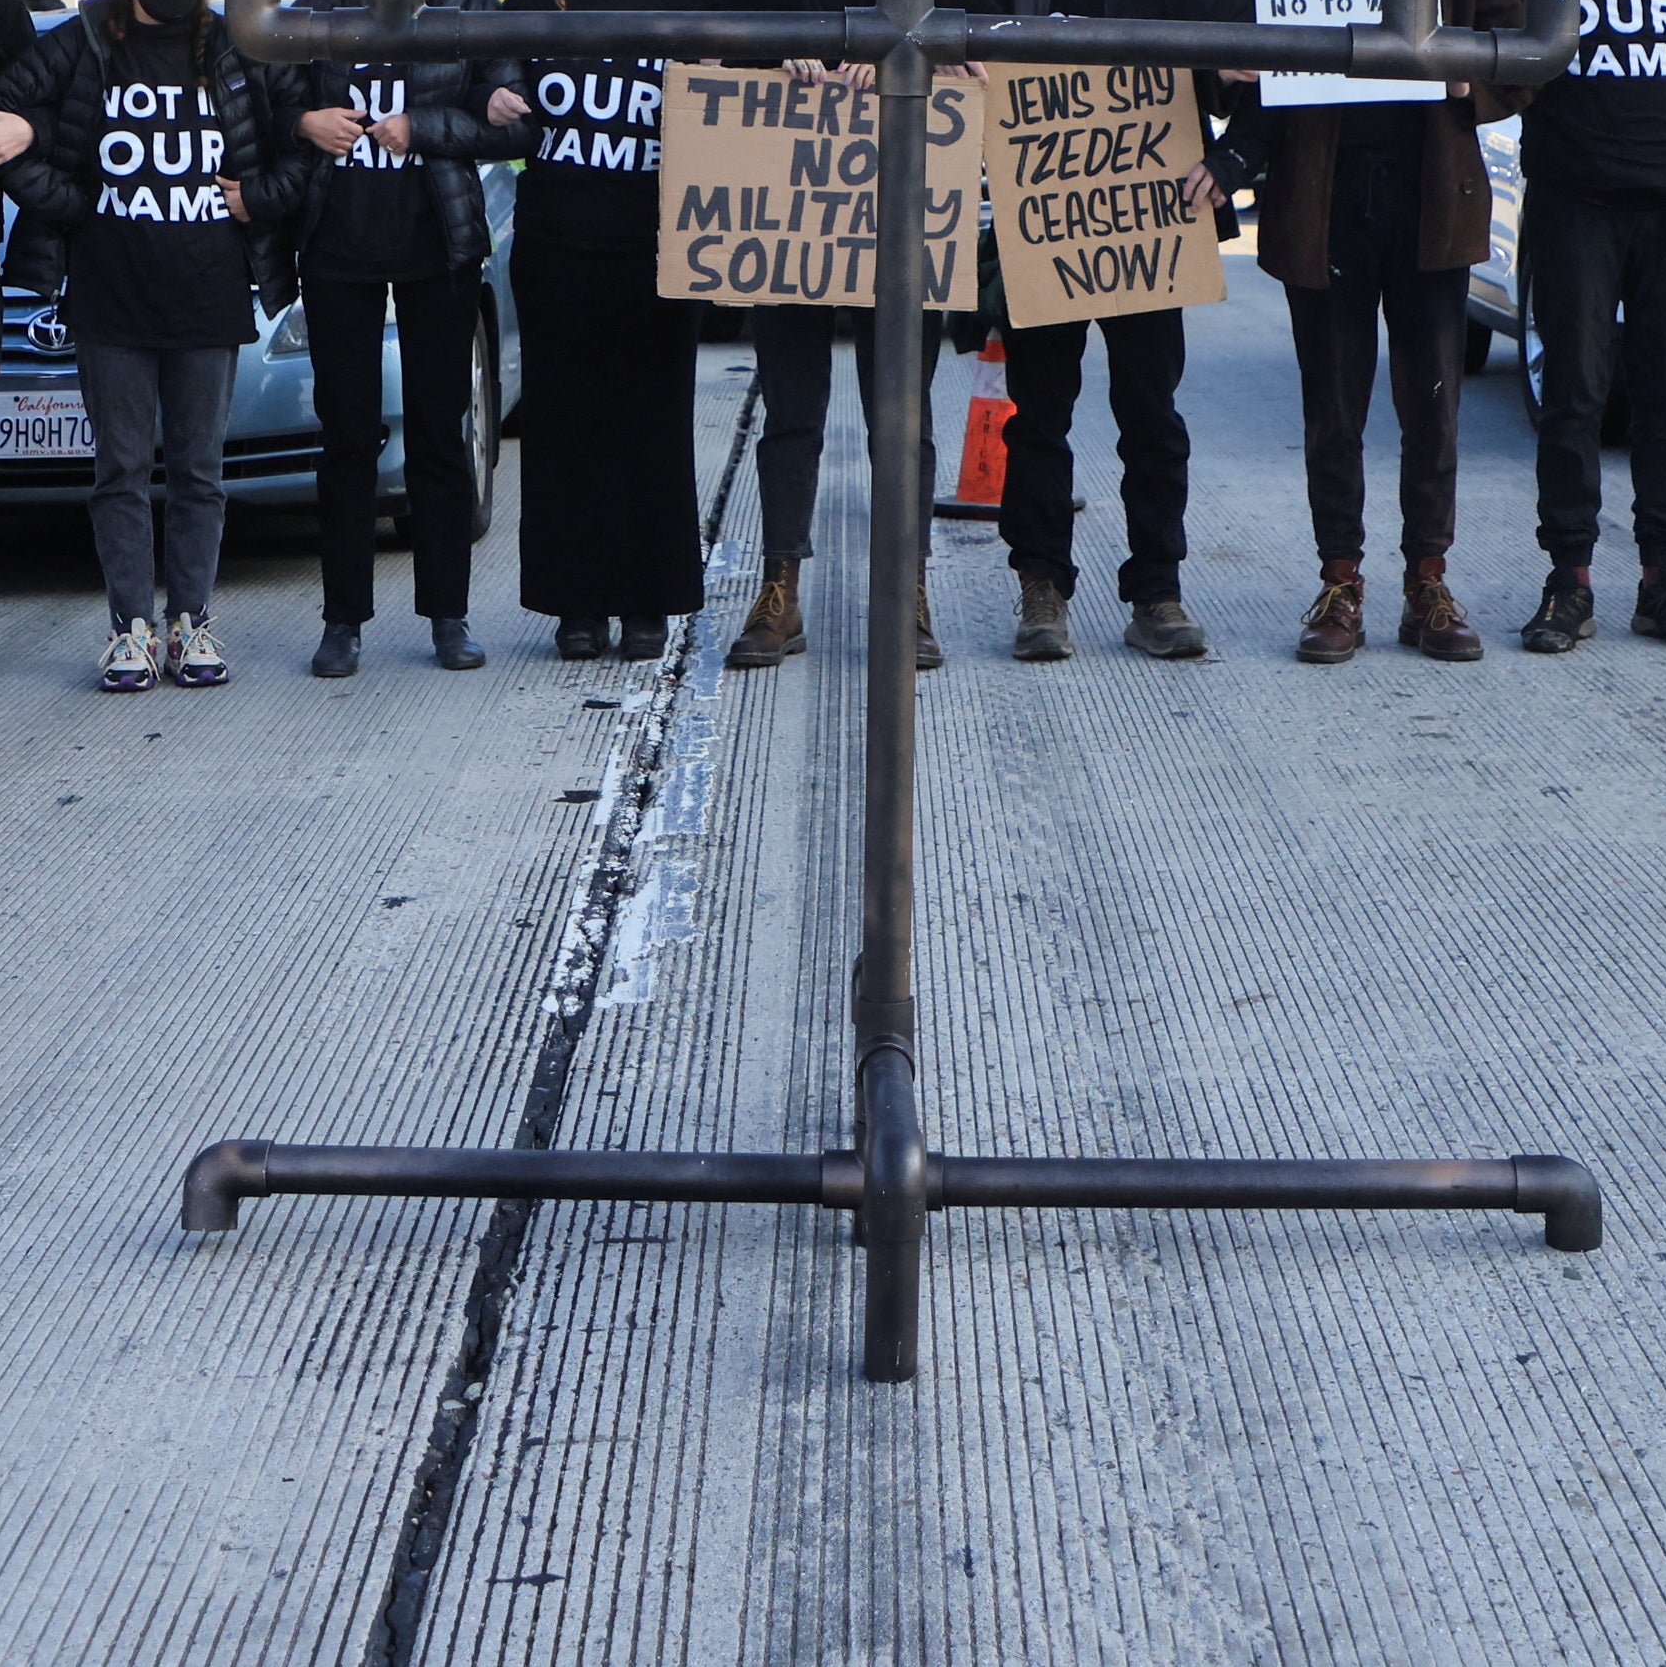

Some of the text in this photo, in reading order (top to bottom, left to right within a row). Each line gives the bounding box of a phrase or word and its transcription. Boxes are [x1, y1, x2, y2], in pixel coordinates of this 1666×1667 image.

[103, 83, 182, 120] NOT
[538, 72, 661, 126] OUR
[687, 77, 875, 136] THERE
[999, 66, 1175, 129] JEWS SAY
[99, 130, 225, 176] OUR
[790, 138, 878, 187] NO
[1008, 120, 1172, 188] TZEDEK
[96, 182, 230, 222] NAME
[676, 185, 962, 239] MILITAY
[1018, 177, 1197, 244] CEASEFIRE
[687, 234, 957, 303] SOLUTN
[1053, 235, 1182, 299] NOW!
